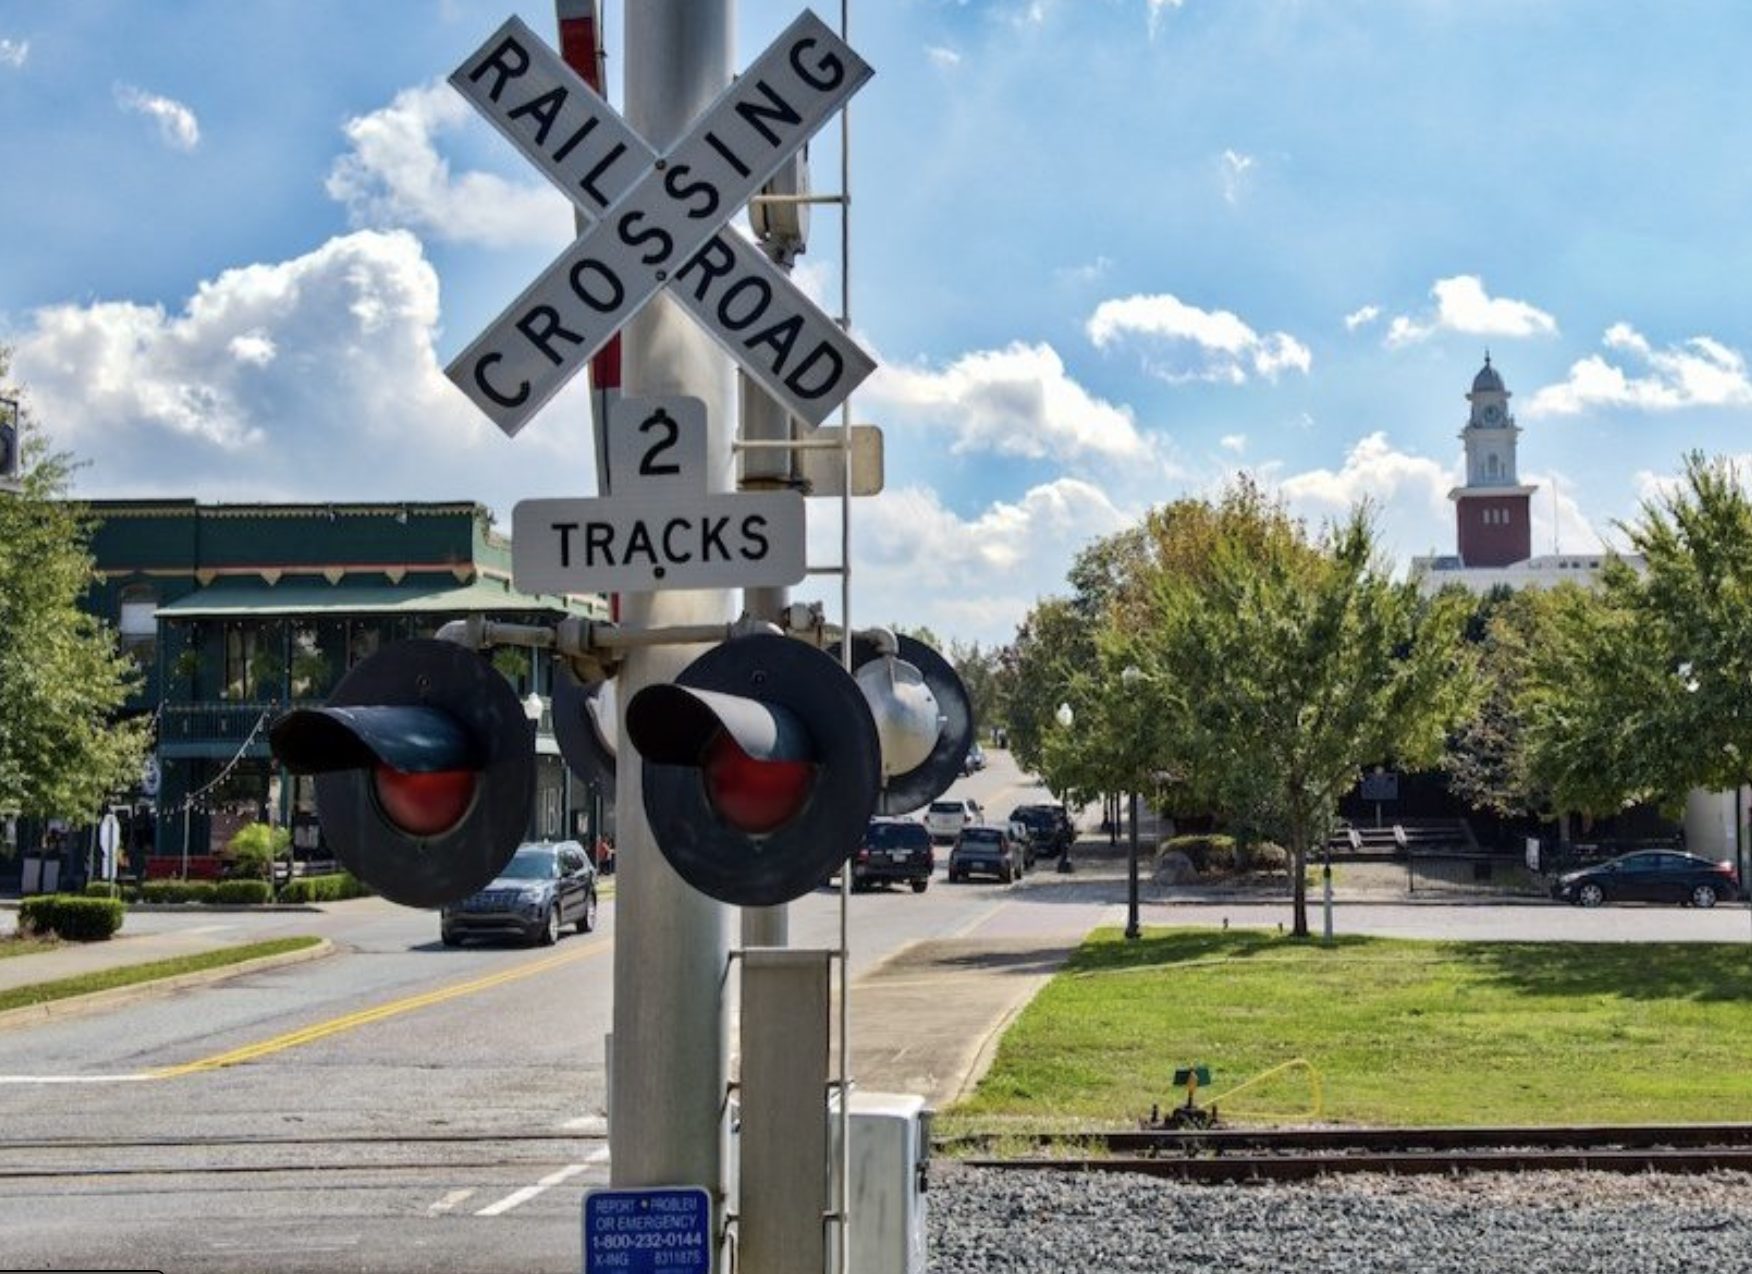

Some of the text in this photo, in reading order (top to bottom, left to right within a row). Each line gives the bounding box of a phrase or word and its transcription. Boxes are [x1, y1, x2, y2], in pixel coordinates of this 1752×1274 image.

[469, 36, 844, 400] RAIL ROAD
[474, 37, 845, 408] CROSSING
[638, 411, 680, 476] 2
[551, 514, 769, 567] TRACKS
[596, 1197, 697, 1213] REPORT PROBLEM
[596, 1215, 697, 1230] OR EMERGENCY
[593, 1232, 702, 1249] 1-800-232-0144
[594, 1252, 630, 1266] X-ING
